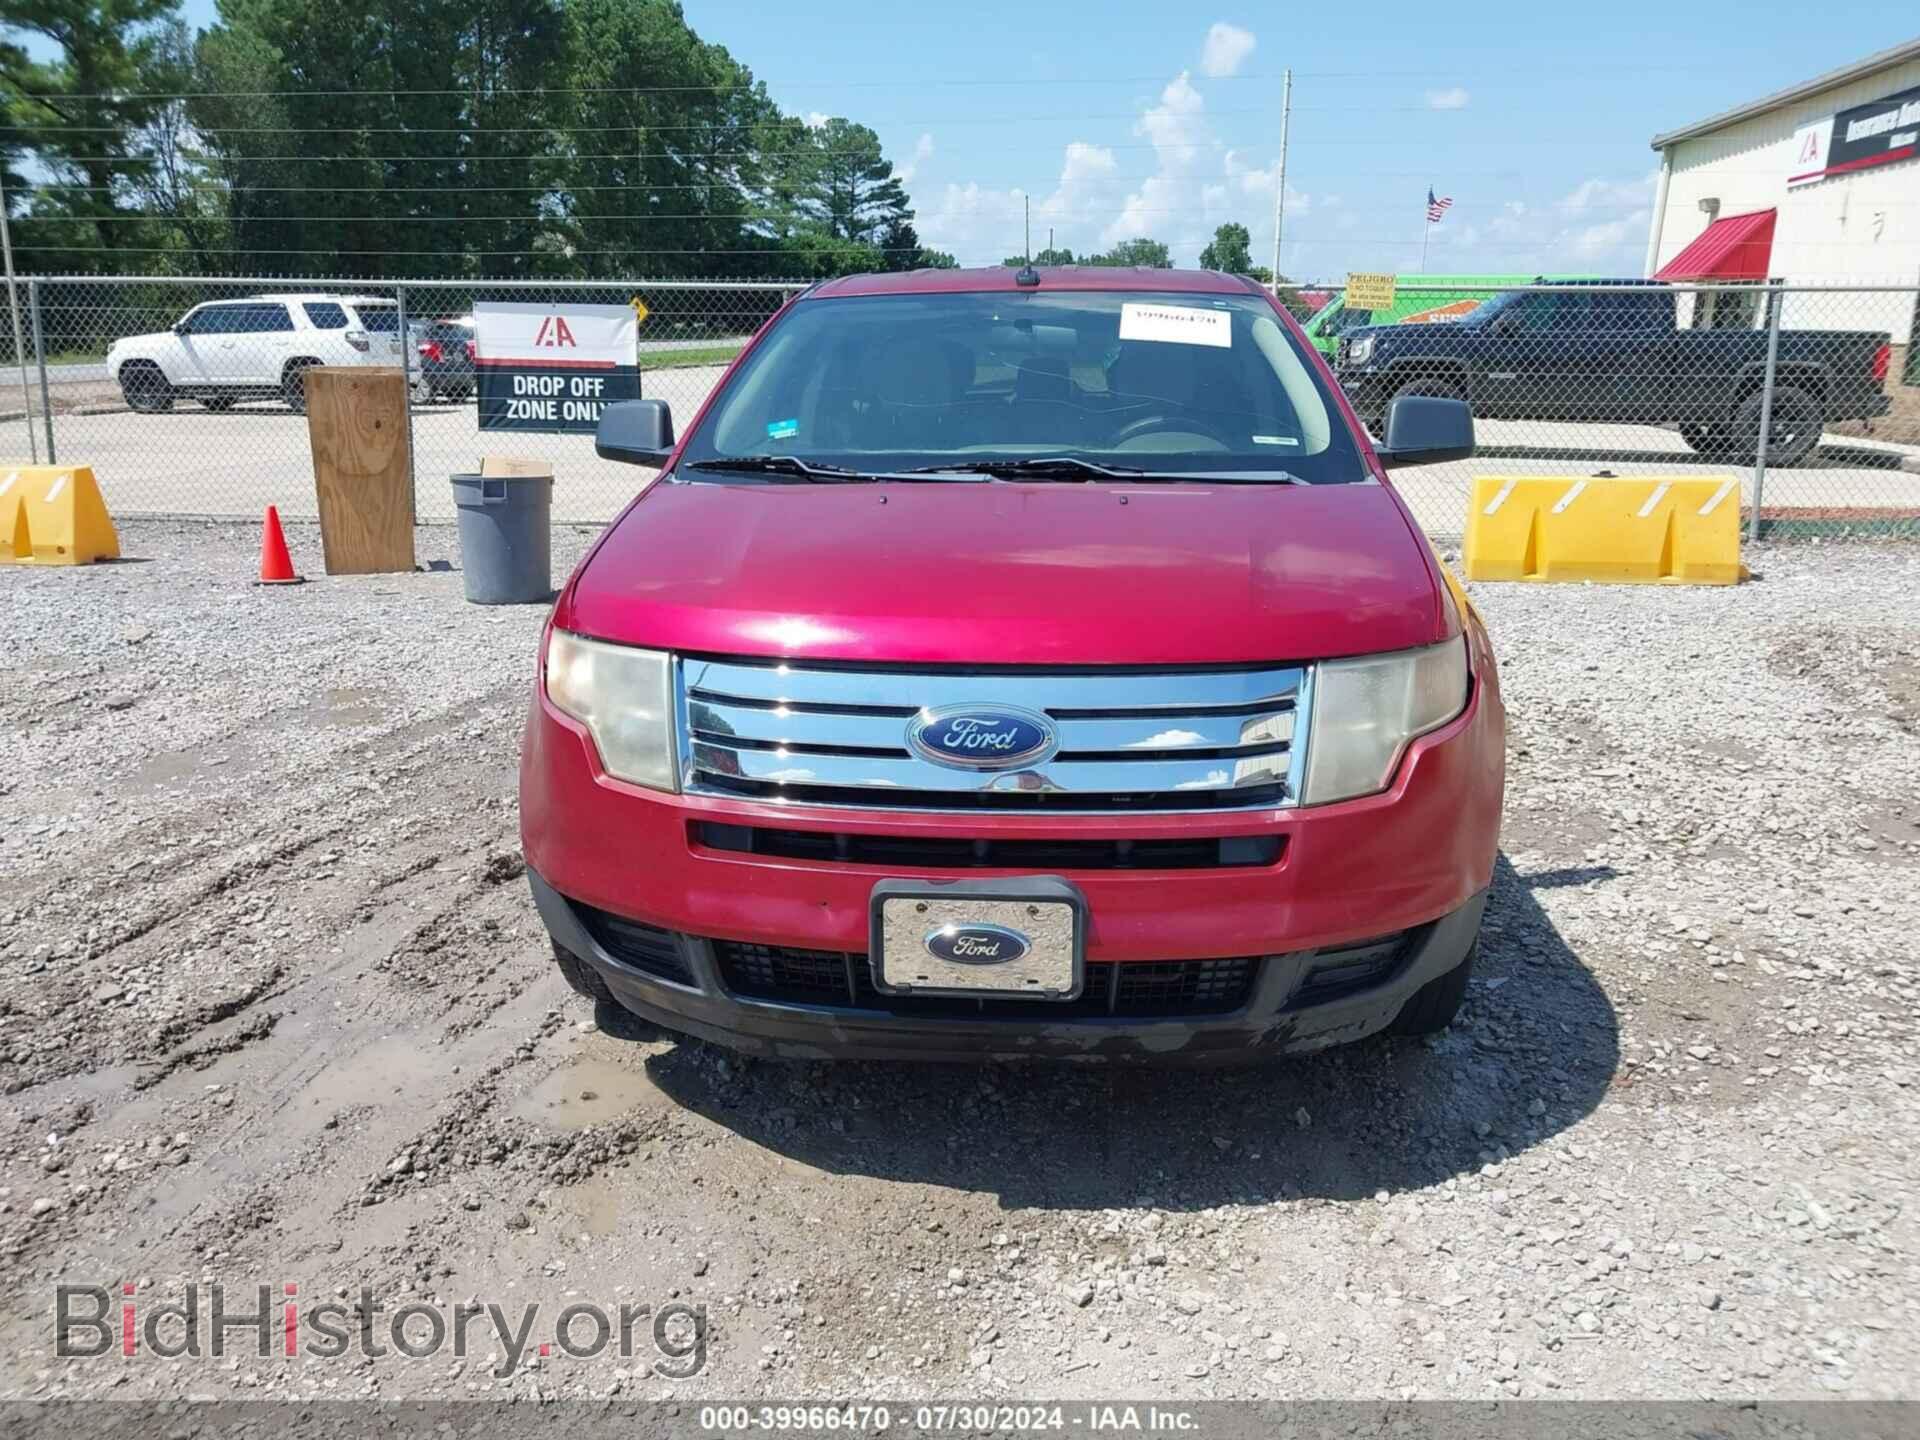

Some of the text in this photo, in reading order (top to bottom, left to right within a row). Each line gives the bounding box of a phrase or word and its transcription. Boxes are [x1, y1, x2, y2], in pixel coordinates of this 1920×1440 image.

[1350, 274, 1394, 284] PELIGRO
[513, 375, 604, 397] DROP OFF
[507, 399, 558, 420] ZONE
[943, 717, 1019, 749] Ford
[952, 936, 1001, 957] Ford
